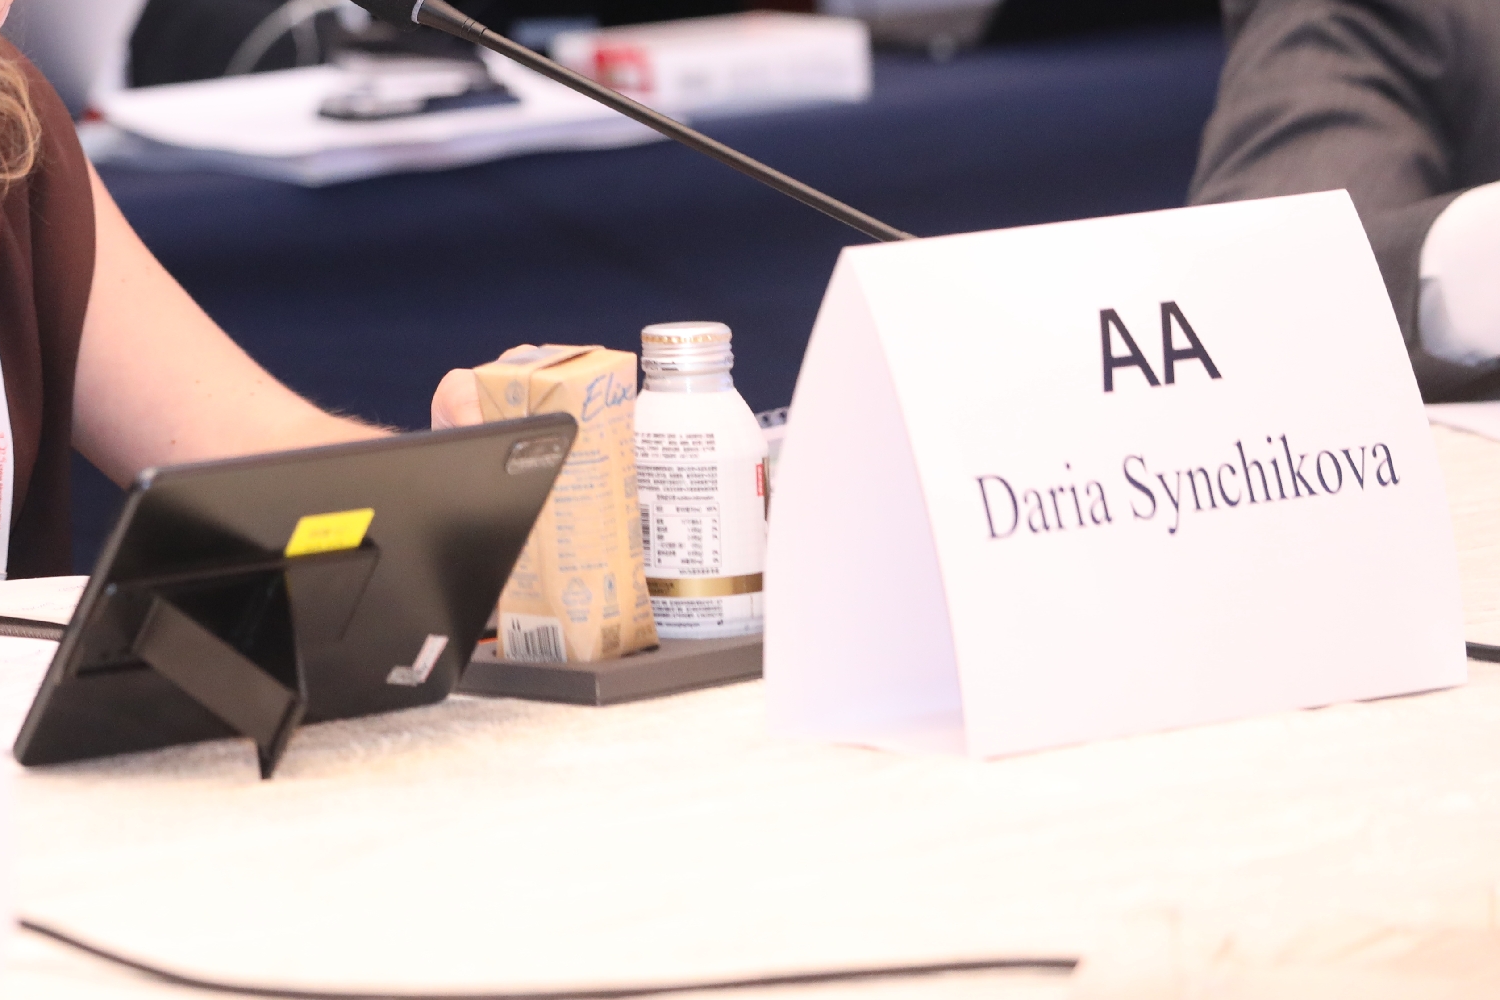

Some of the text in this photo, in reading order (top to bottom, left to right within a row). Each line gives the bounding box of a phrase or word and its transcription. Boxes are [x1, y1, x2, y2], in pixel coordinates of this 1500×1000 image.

[1100, 300, 1223, 393] AA
[975, 433, 1400, 540] Daria Synchikova
